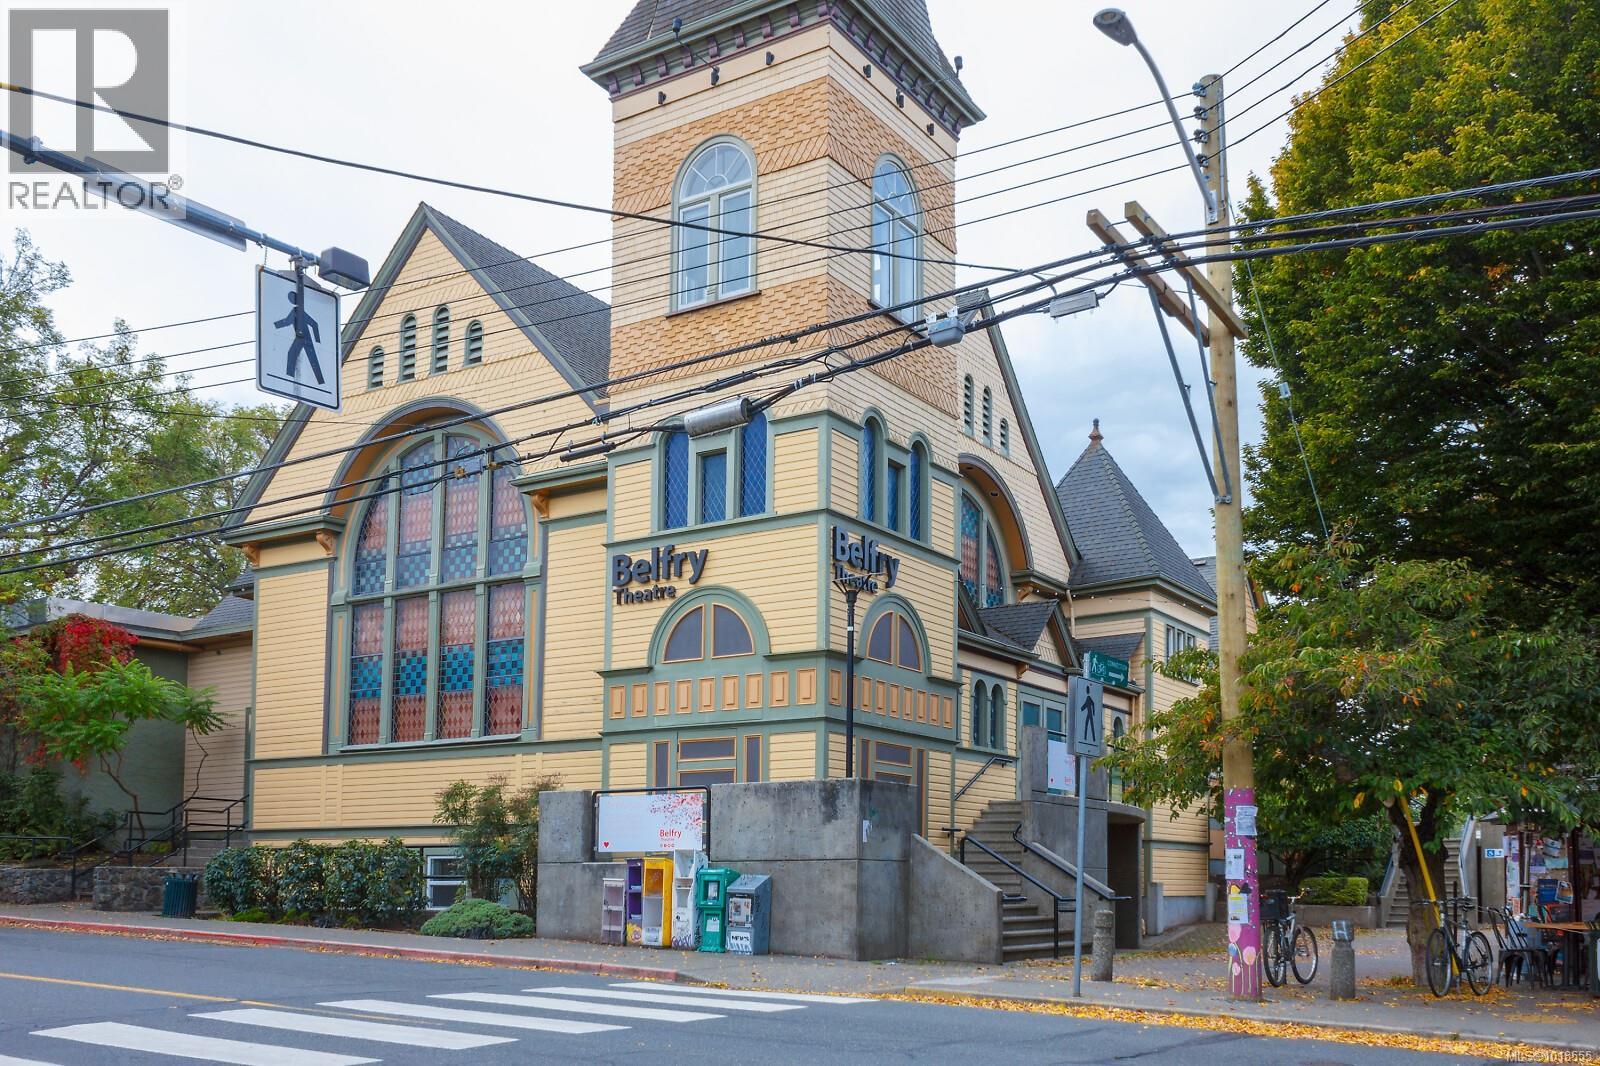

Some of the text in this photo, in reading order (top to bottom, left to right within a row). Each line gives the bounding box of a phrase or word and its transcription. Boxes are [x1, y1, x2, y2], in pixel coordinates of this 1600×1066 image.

[612, 544, 709, 587] Belfry
[833, 526, 900, 589] Belfry
[613, 584, 677, 606] Theatre
[659, 829, 682, 838] Belfry
